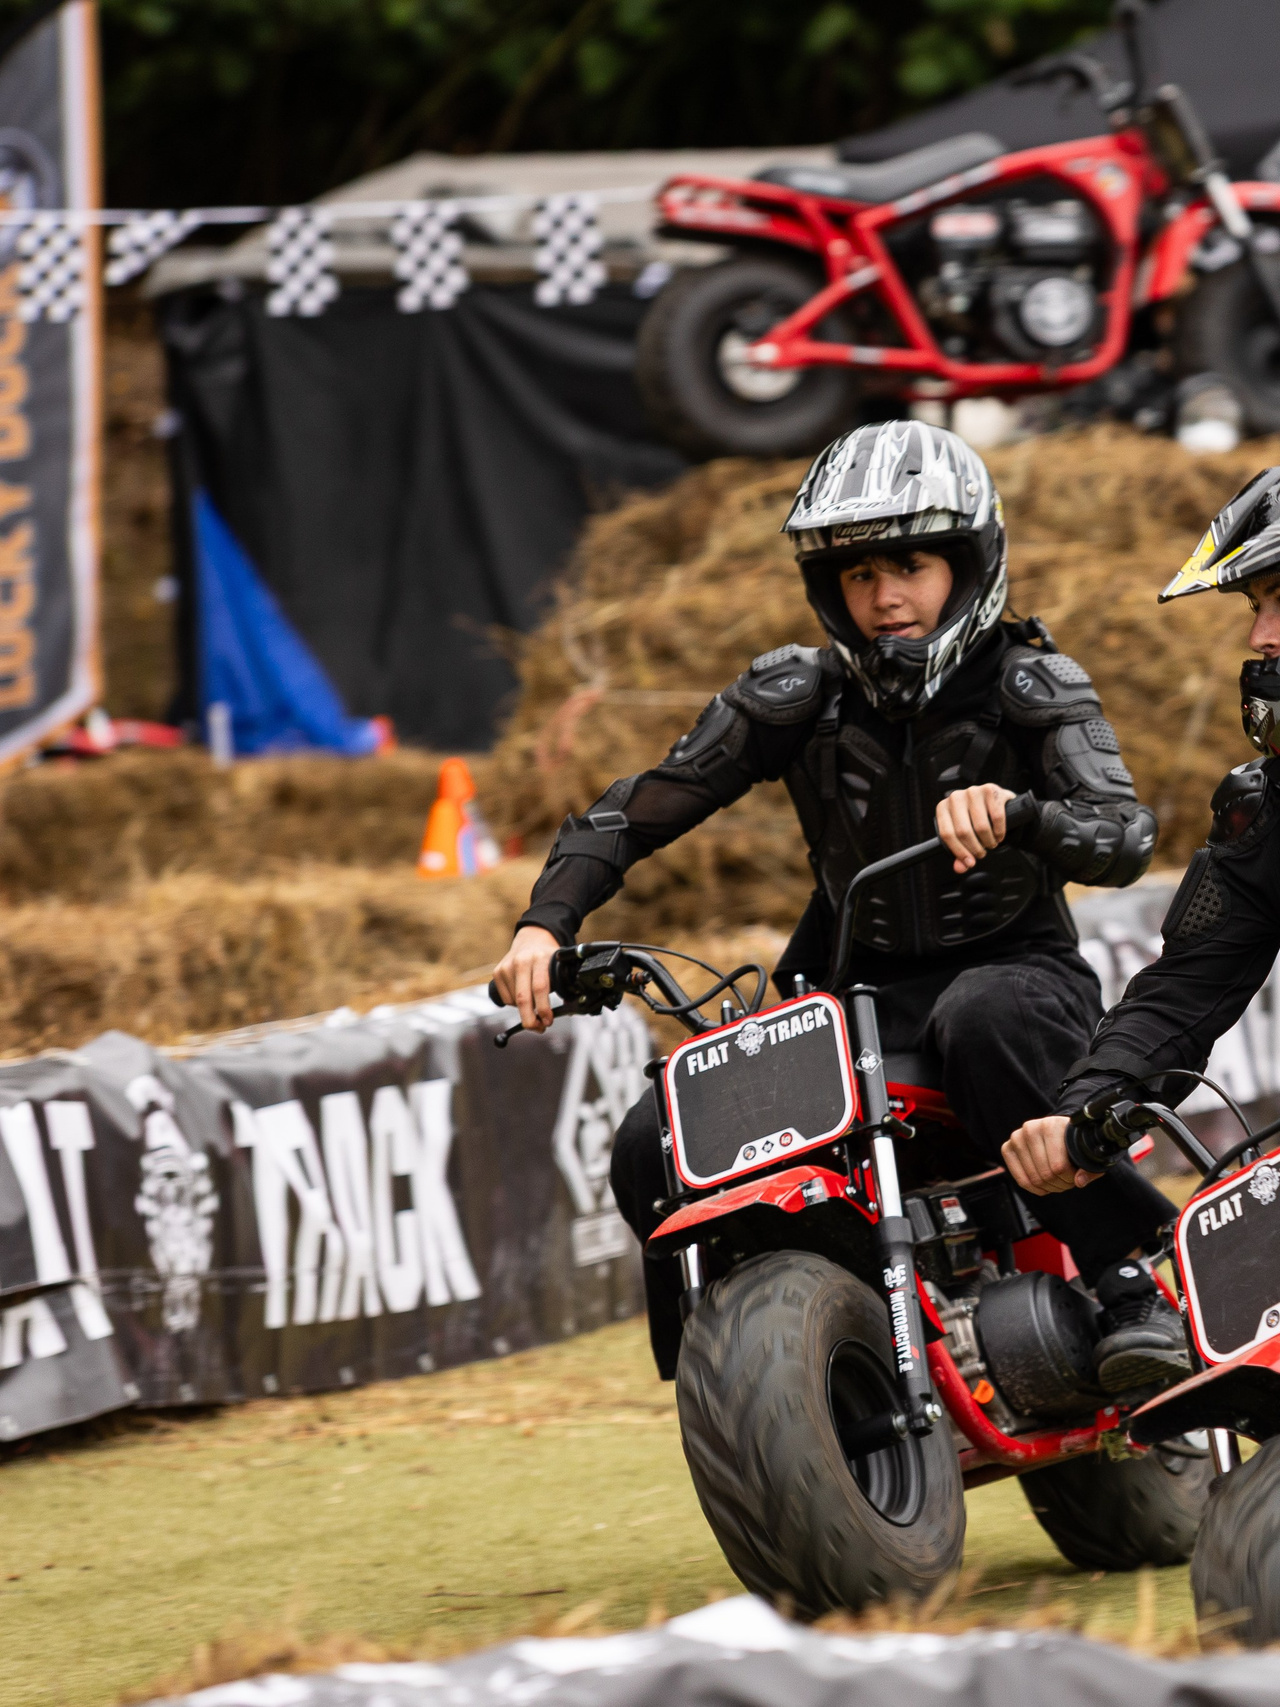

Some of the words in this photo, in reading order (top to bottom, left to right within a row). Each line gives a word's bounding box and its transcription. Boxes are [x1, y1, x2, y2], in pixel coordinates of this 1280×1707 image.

[686, 1042, 729, 1076] FLAT
[765, 1005, 829, 1045] TRACK
[1198, 1192, 1243, 1236] FLAT
